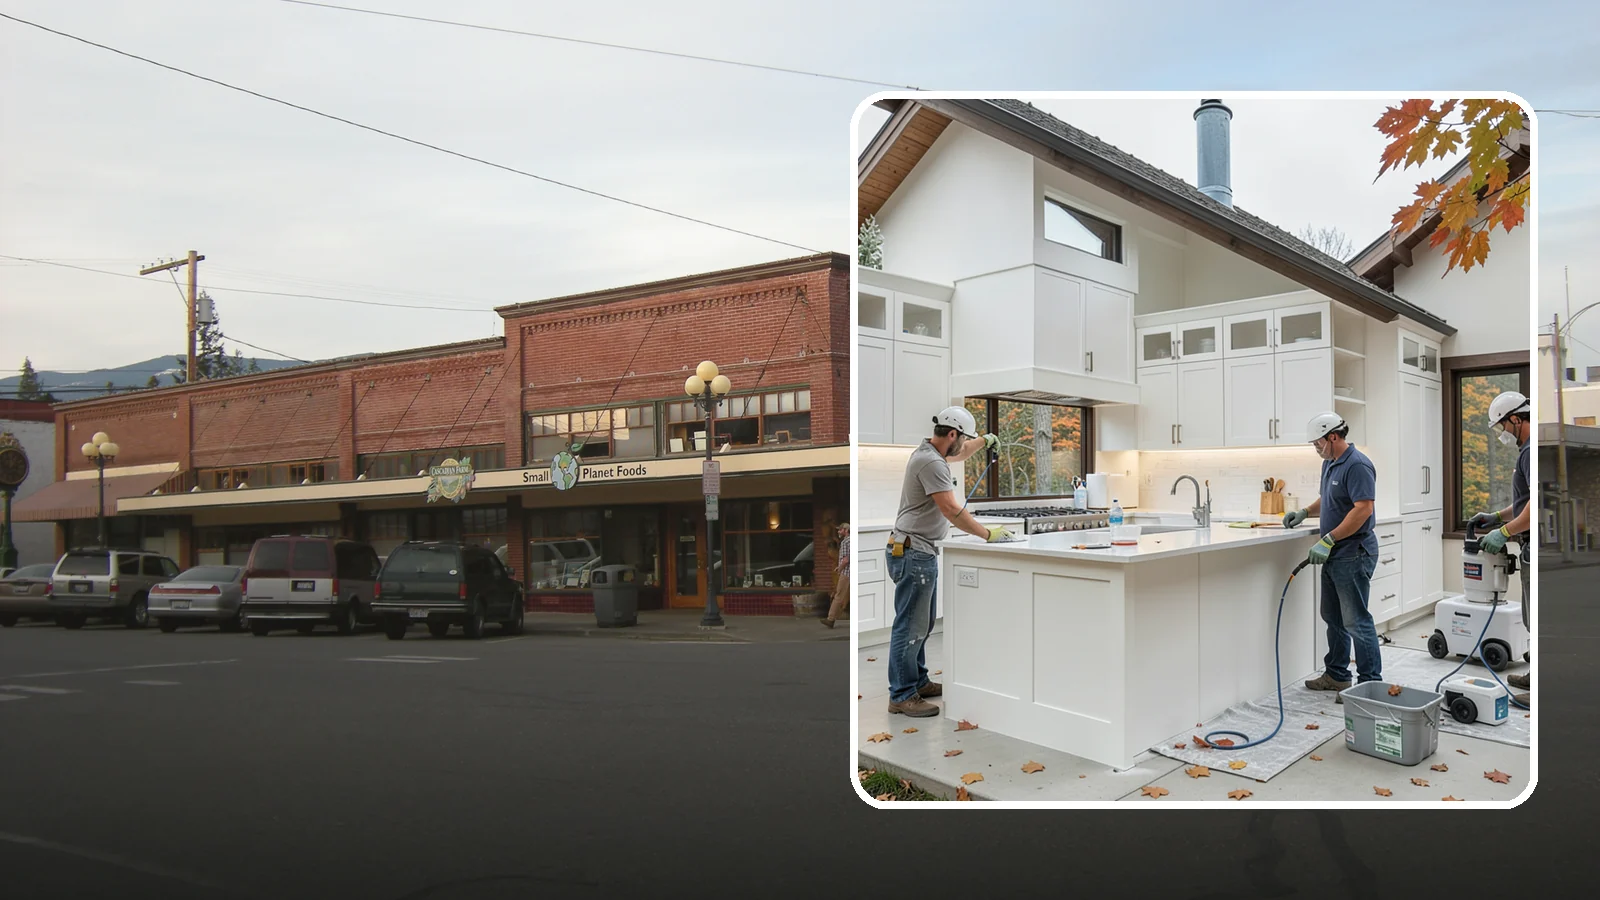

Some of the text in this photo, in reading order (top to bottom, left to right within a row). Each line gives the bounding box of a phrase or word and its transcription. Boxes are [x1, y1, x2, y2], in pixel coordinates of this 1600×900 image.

[523, 464, 647, 483] Small Planet Foods
